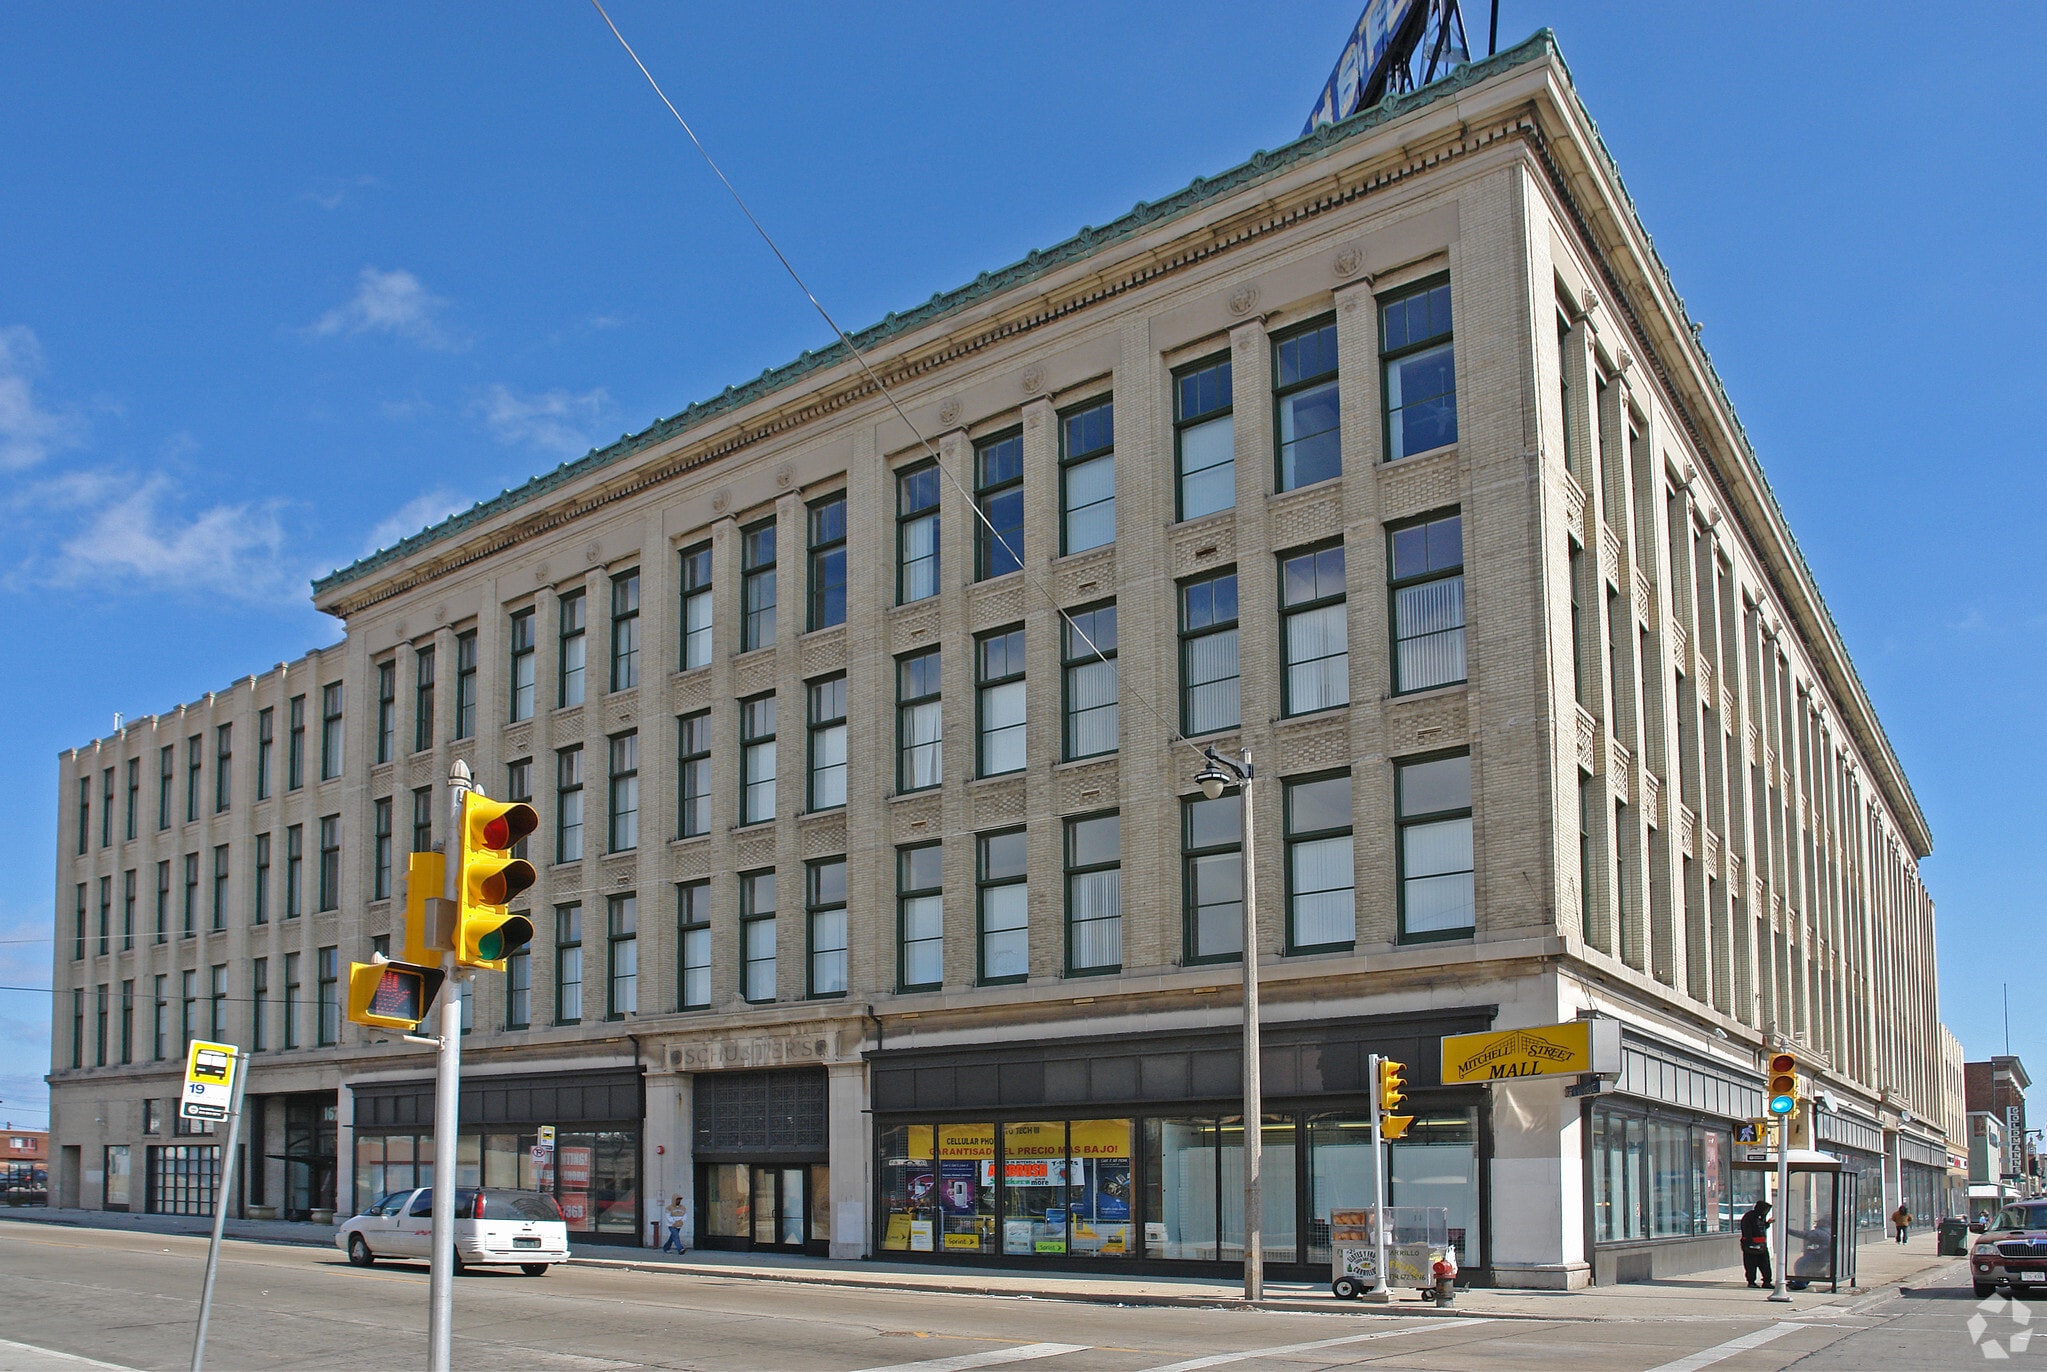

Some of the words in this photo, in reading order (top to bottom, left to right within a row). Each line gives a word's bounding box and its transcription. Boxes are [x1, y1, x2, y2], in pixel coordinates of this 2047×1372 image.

[685, 1039, 813, 1064] SCHUSTER'S
[1458, 1046, 1511, 1076] MITCHELL
[1528, 1045, 1575, 1062] STREET
[1489, 1060, 1543, 1080] MALL
[189, 1083, 205, 1095] 19
[946, 1137, 979, 1145] CELLULAR
[981, 1137, 995, 1145] PHO
[929, 1147, 996, 1156] GRANTISAD
[1018, 1146, 1055, 1155] PRECIO
[1083, 1145, 1118, 1154] BAJO!
